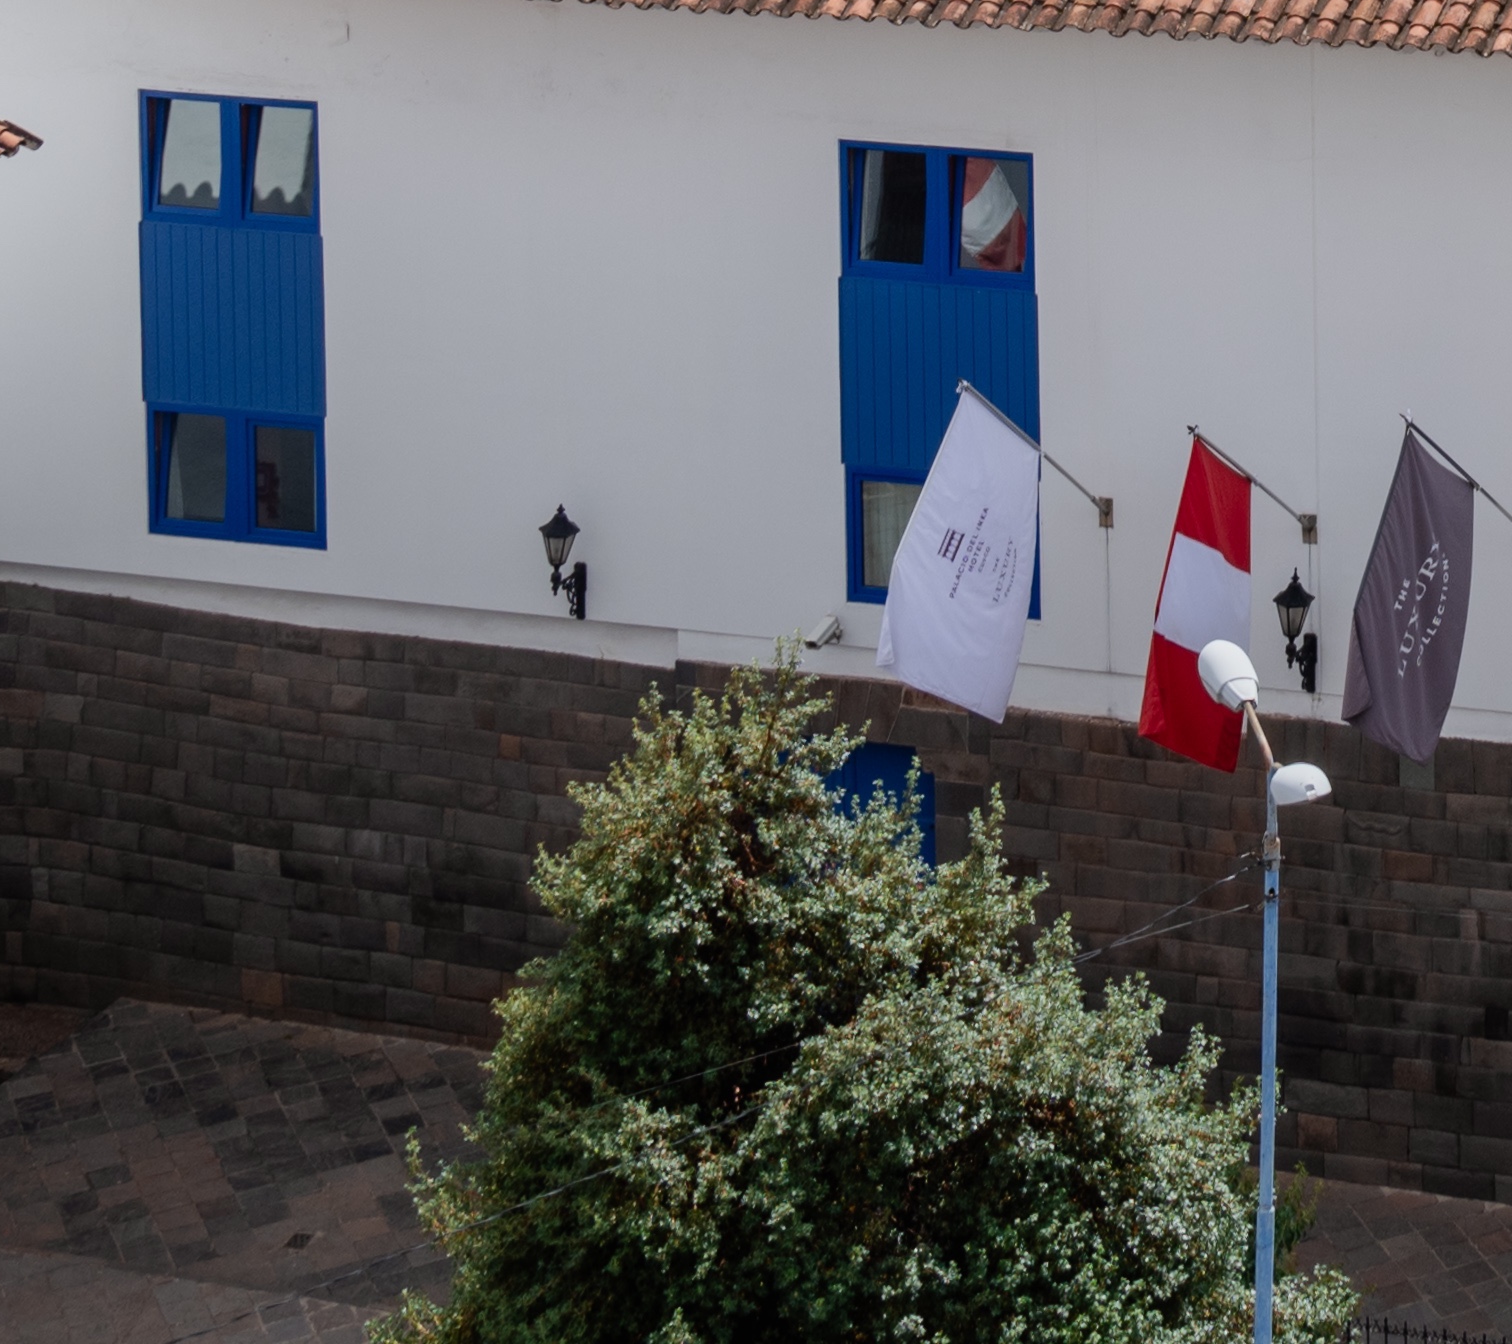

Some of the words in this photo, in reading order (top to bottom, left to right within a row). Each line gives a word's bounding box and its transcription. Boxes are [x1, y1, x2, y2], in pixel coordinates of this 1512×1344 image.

[949, 554, 969, 599] PALACIO
[967, 533, 979, 553] DEL
[976, 507, 989, 531] INKA
[968, 541, 985, 573] HOTEL
[1394, 578, 1410, 611] THE
[1397, 541, 1440, 679] LUXURY
[1416, 558, 1449, 667] COLLECTION
